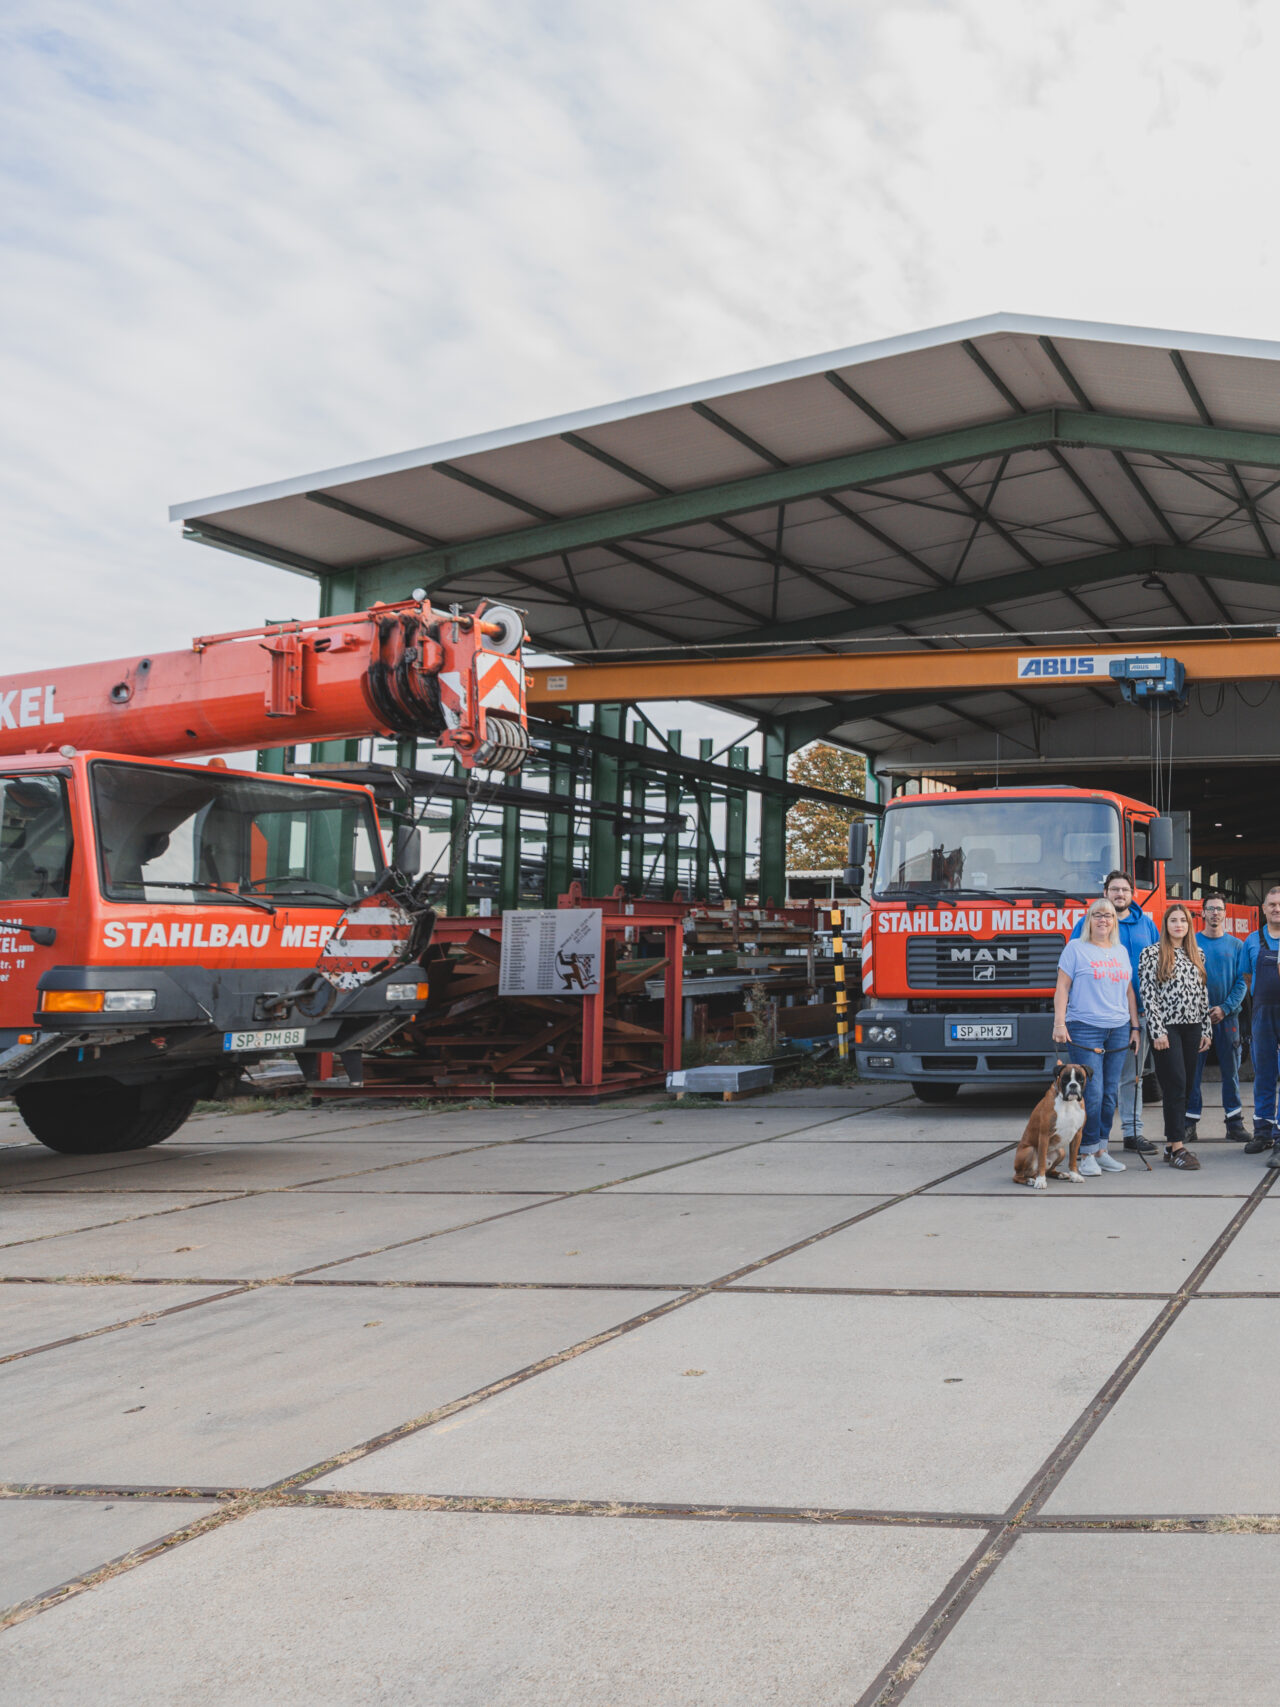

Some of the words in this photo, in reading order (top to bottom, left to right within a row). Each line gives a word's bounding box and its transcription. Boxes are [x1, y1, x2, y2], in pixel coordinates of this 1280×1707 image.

[1021, 657, 1094, 676] ABUS
[878, 910, 983, 933] STAHLBAU
[991, 908, 1090, 931] MERCKE
[103, 922, 271, 948] STAHLBAU
[950, 948, 1017, 961] MAN
[236, 1034, 255, 1048] SP
[264, 1032, 282, 1046] PM
[283, 1031, 300, 1044] 88
[960, 1027, 974, 1037] SP
[980, 1027, 994, 1037] PM
[995, 1026, 1008, 1036] 37
